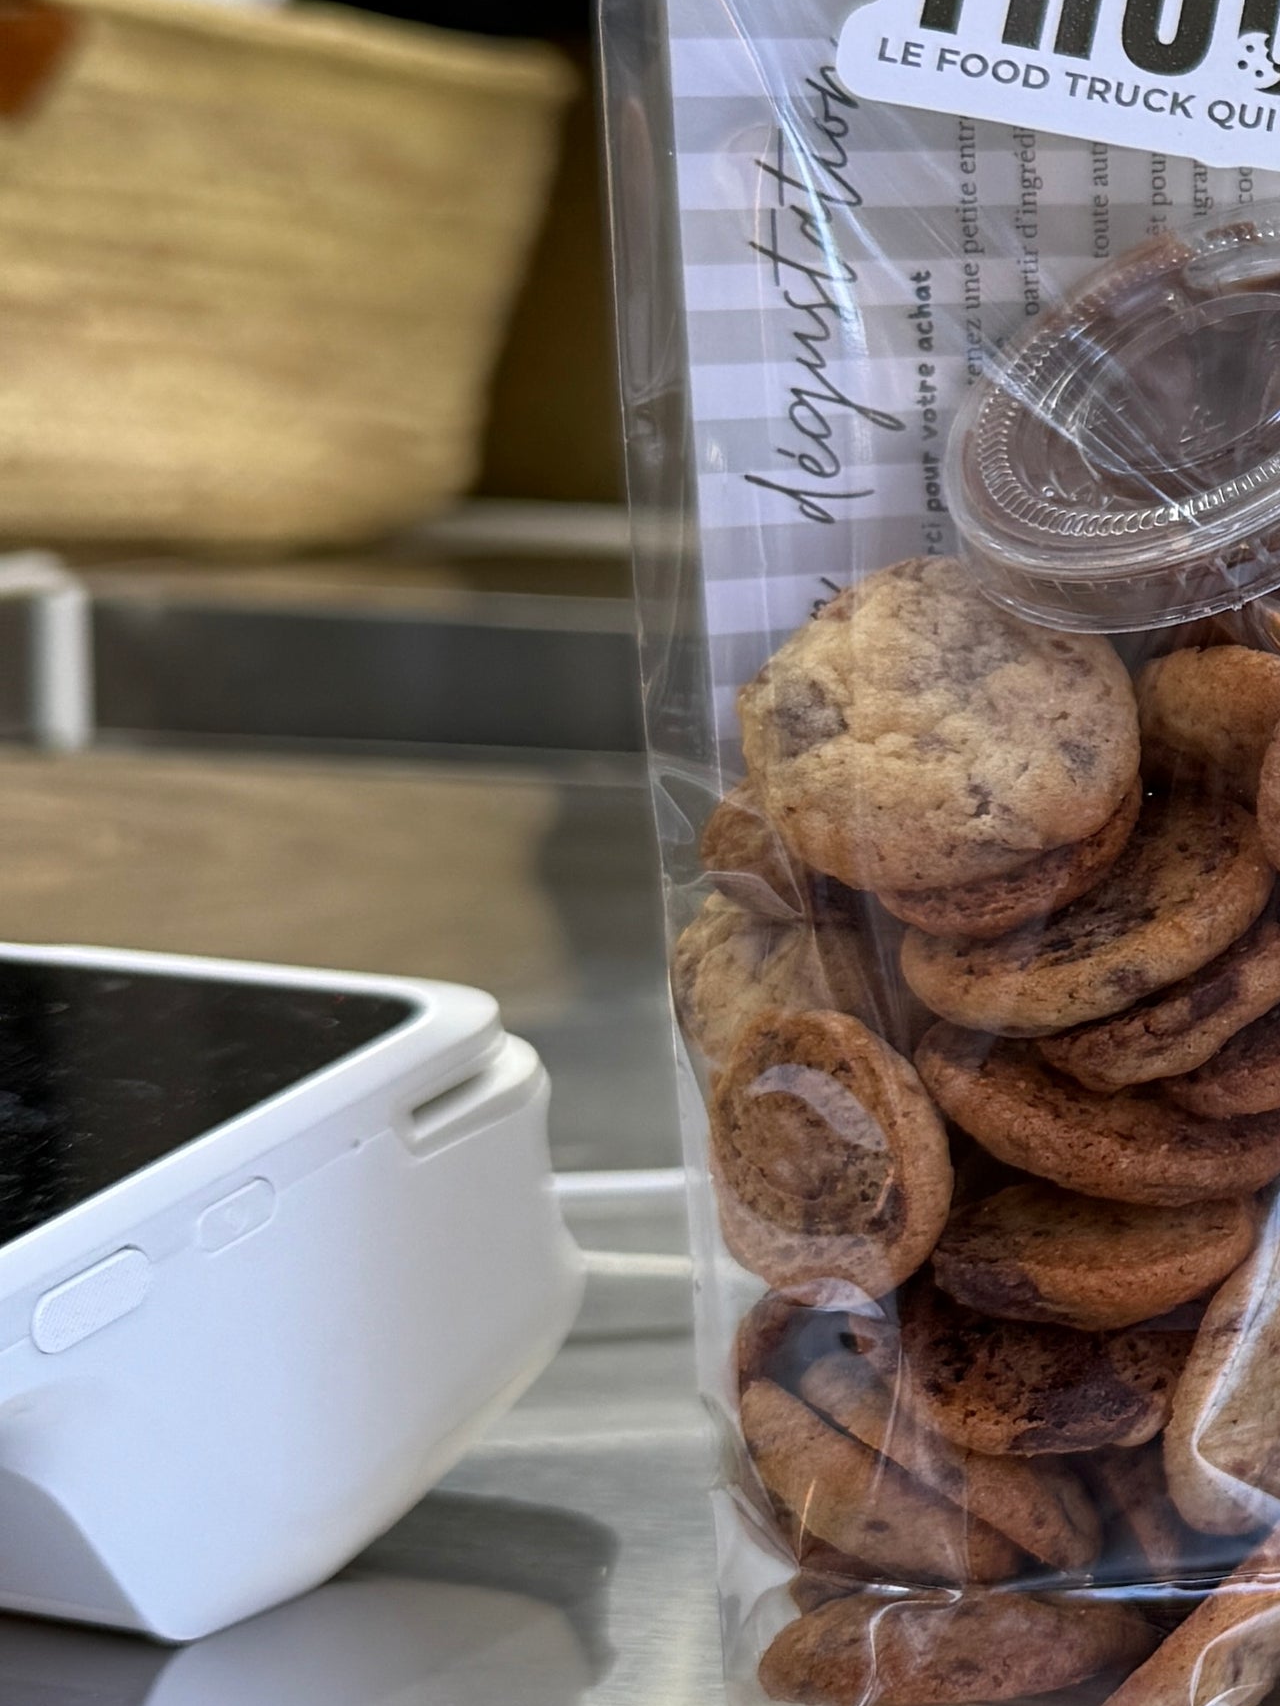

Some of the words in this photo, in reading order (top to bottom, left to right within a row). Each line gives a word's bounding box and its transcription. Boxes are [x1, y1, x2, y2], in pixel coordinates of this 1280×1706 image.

[877, 37, 922, 69] LE
[936, 49, 1051, 90] FOOD
[1065, 71, 1198, 119] TRUCK
[1207, 99, 1276, 133] QUI
[955, 182, 984, 254] petite
[1091, 195, 1110, 258] toute
[907, 270, 935, 353] achat
[960, 263, 981, 310] une
[918, 362, 938, 441] votre
[922, 451, 949, 513] pour
